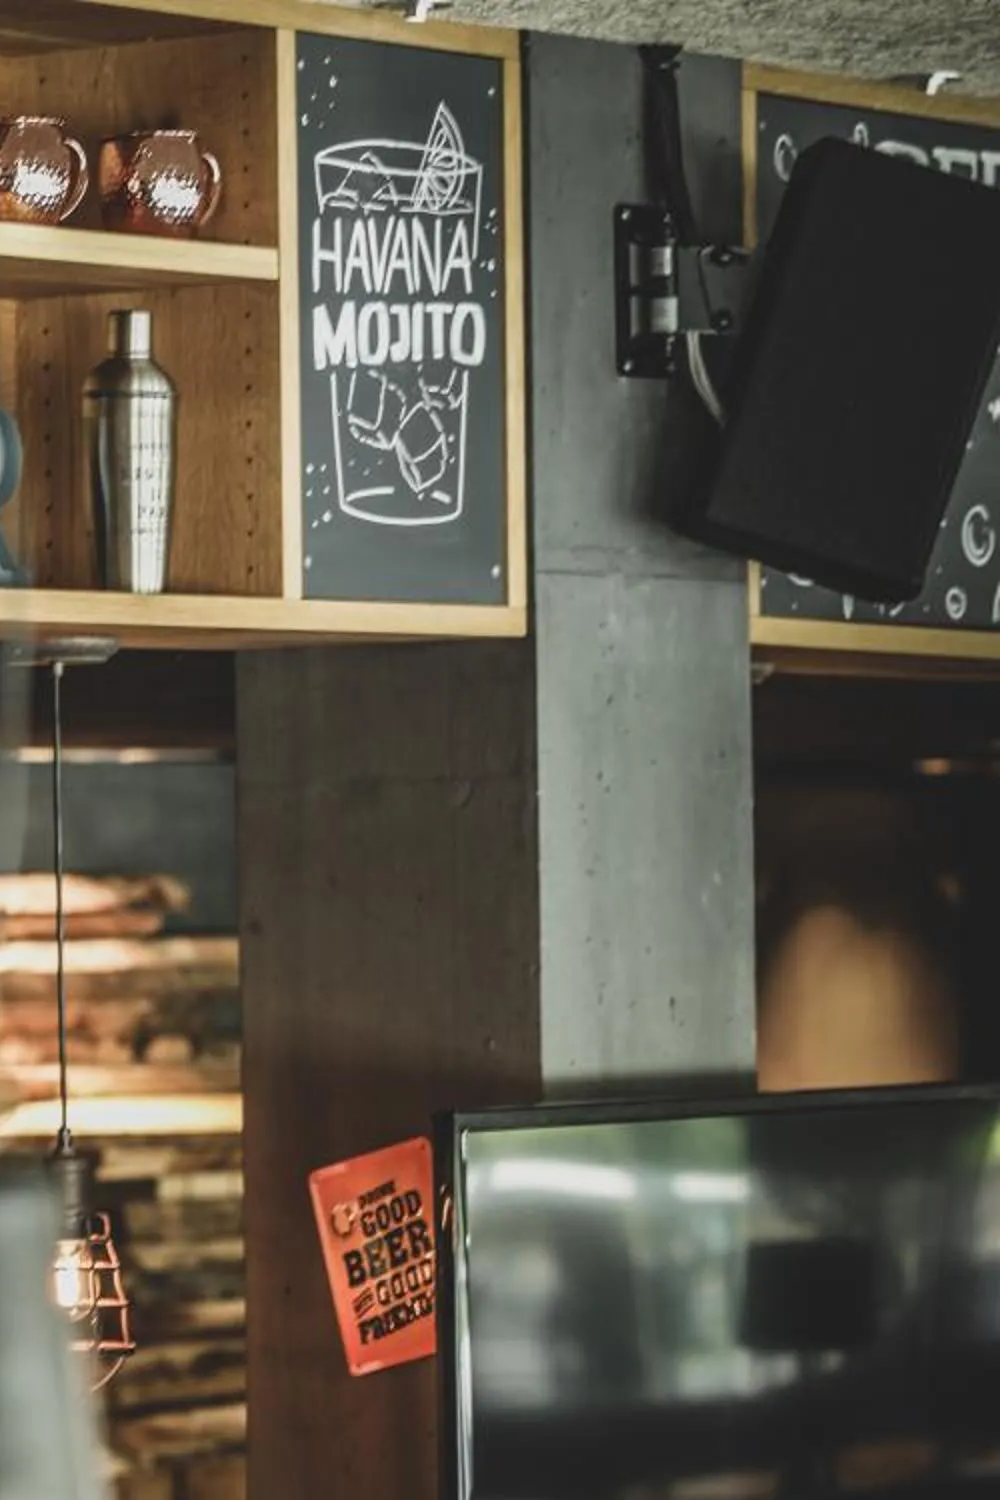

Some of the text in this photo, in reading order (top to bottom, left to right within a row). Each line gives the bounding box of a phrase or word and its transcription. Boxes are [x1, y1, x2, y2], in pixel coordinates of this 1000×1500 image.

[312, 214, 473, 296] HAVANA
[312, 301, 486, 370] MOJITO
[360, 1190, 422, 1238] GOOD
[343, 1218, 433, 1288] BEER
[375, 1258, 434, 1306] GOOD
